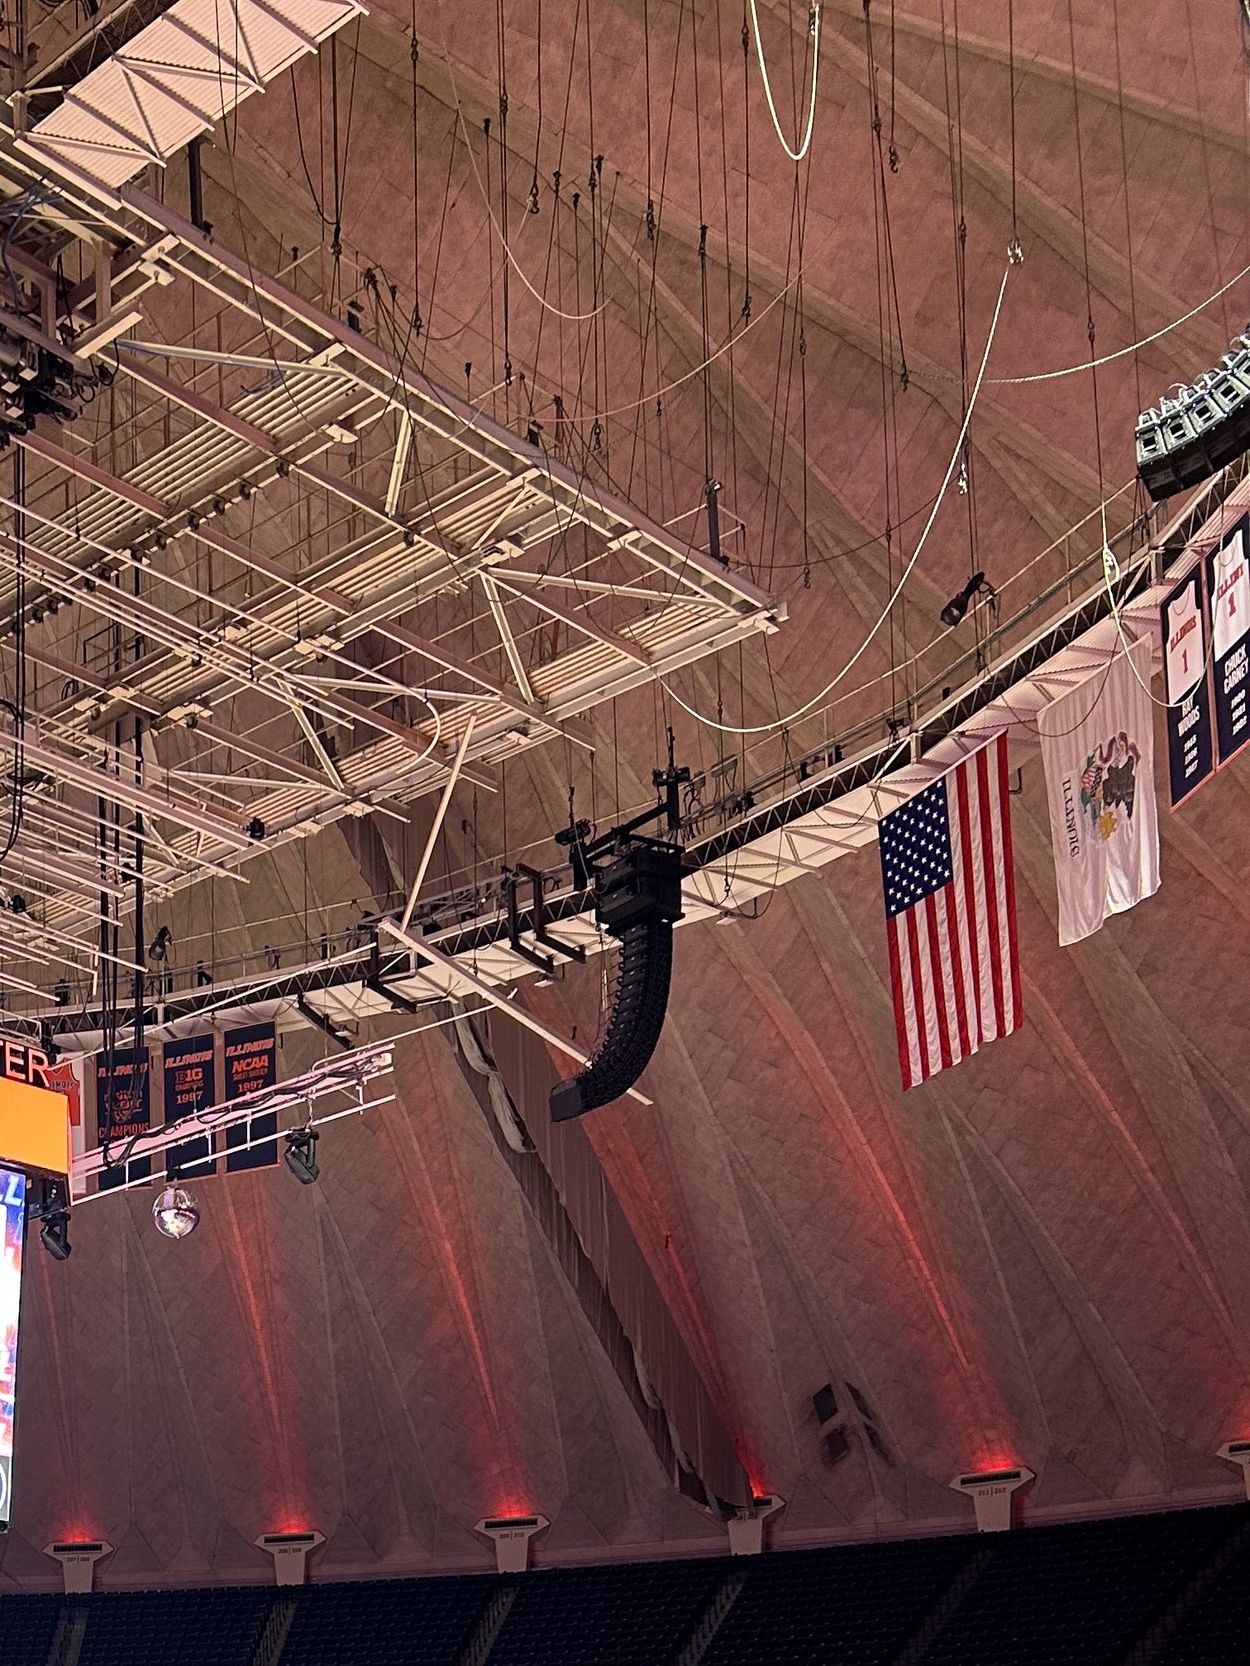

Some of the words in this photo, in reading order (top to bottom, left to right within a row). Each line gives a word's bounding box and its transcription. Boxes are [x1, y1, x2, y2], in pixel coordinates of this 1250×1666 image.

[1228, 591, 1237, 618] 1
[1182, 647, 1189, 674] 1
[231, 1055, 269, 1073] NCAA
